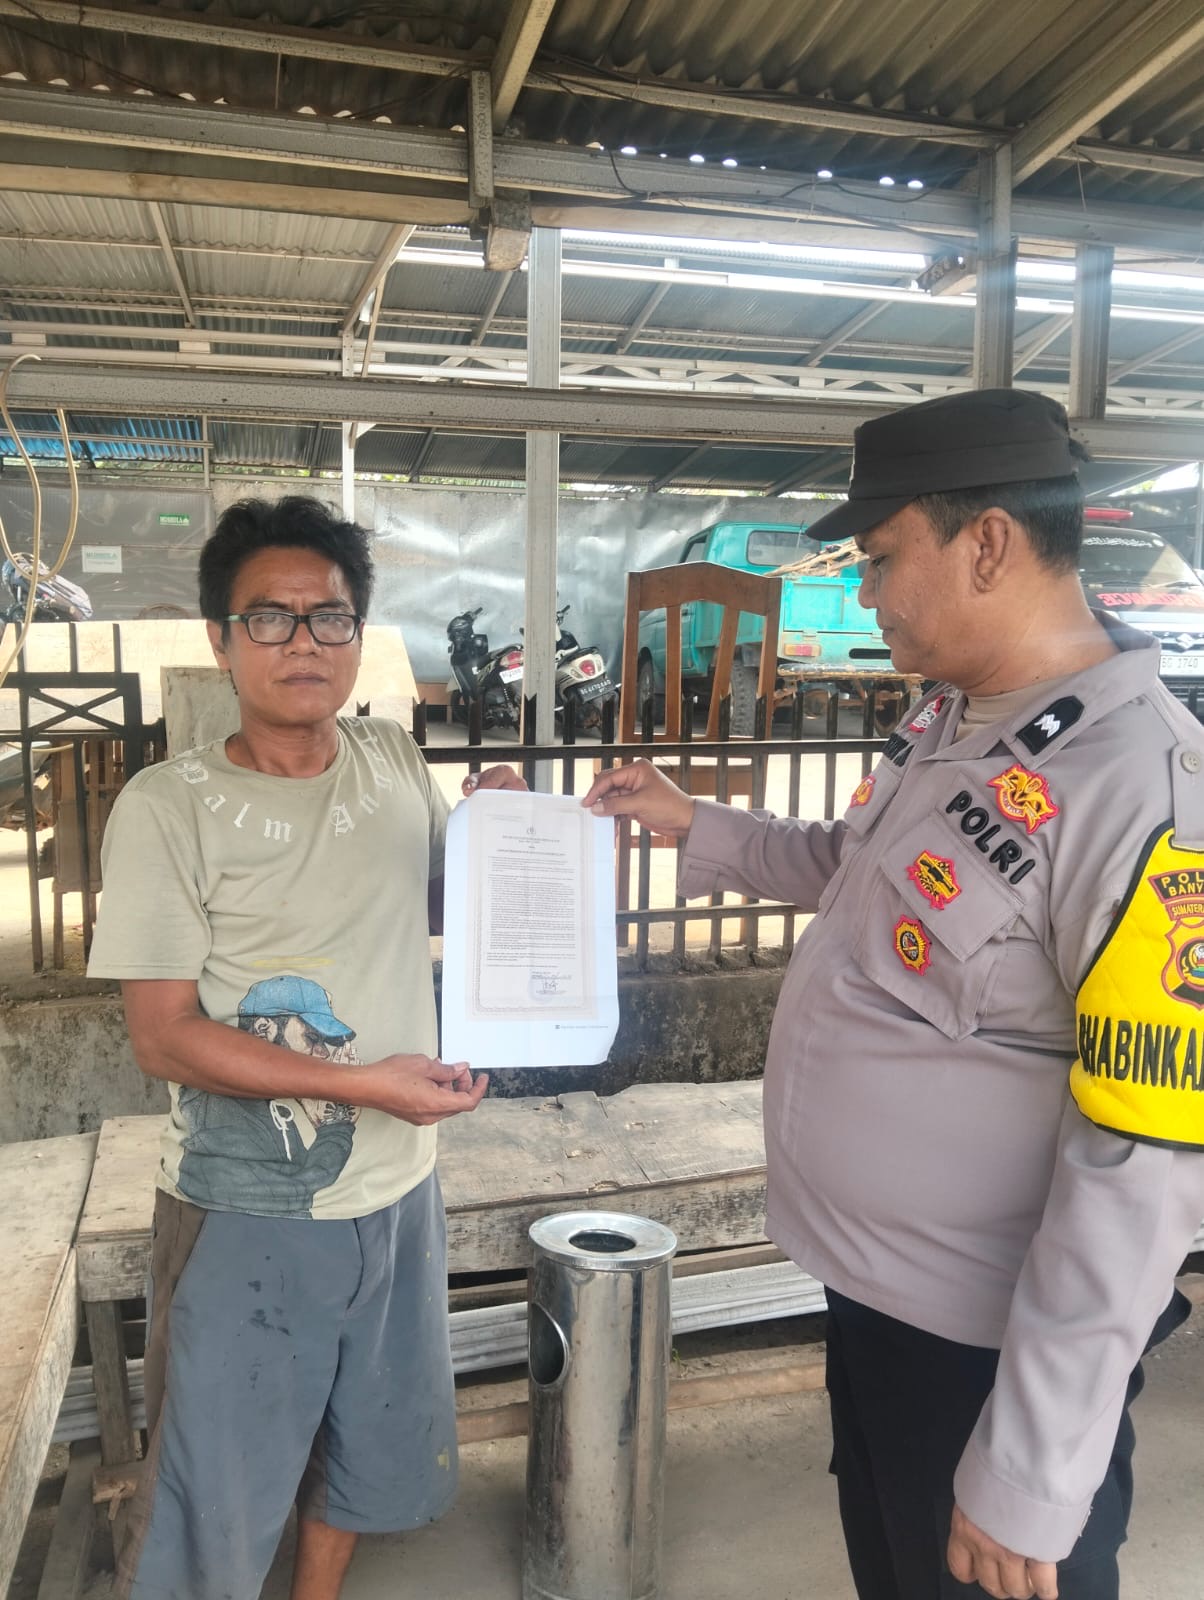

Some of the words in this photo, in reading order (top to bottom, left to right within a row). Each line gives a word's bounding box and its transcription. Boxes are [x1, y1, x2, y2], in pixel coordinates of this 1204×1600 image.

[945, 789, 1037, 885] POLRI
[1161, 871, 1204, 889] POL
[1078, 1013, 1204, 1092] HABINKA
